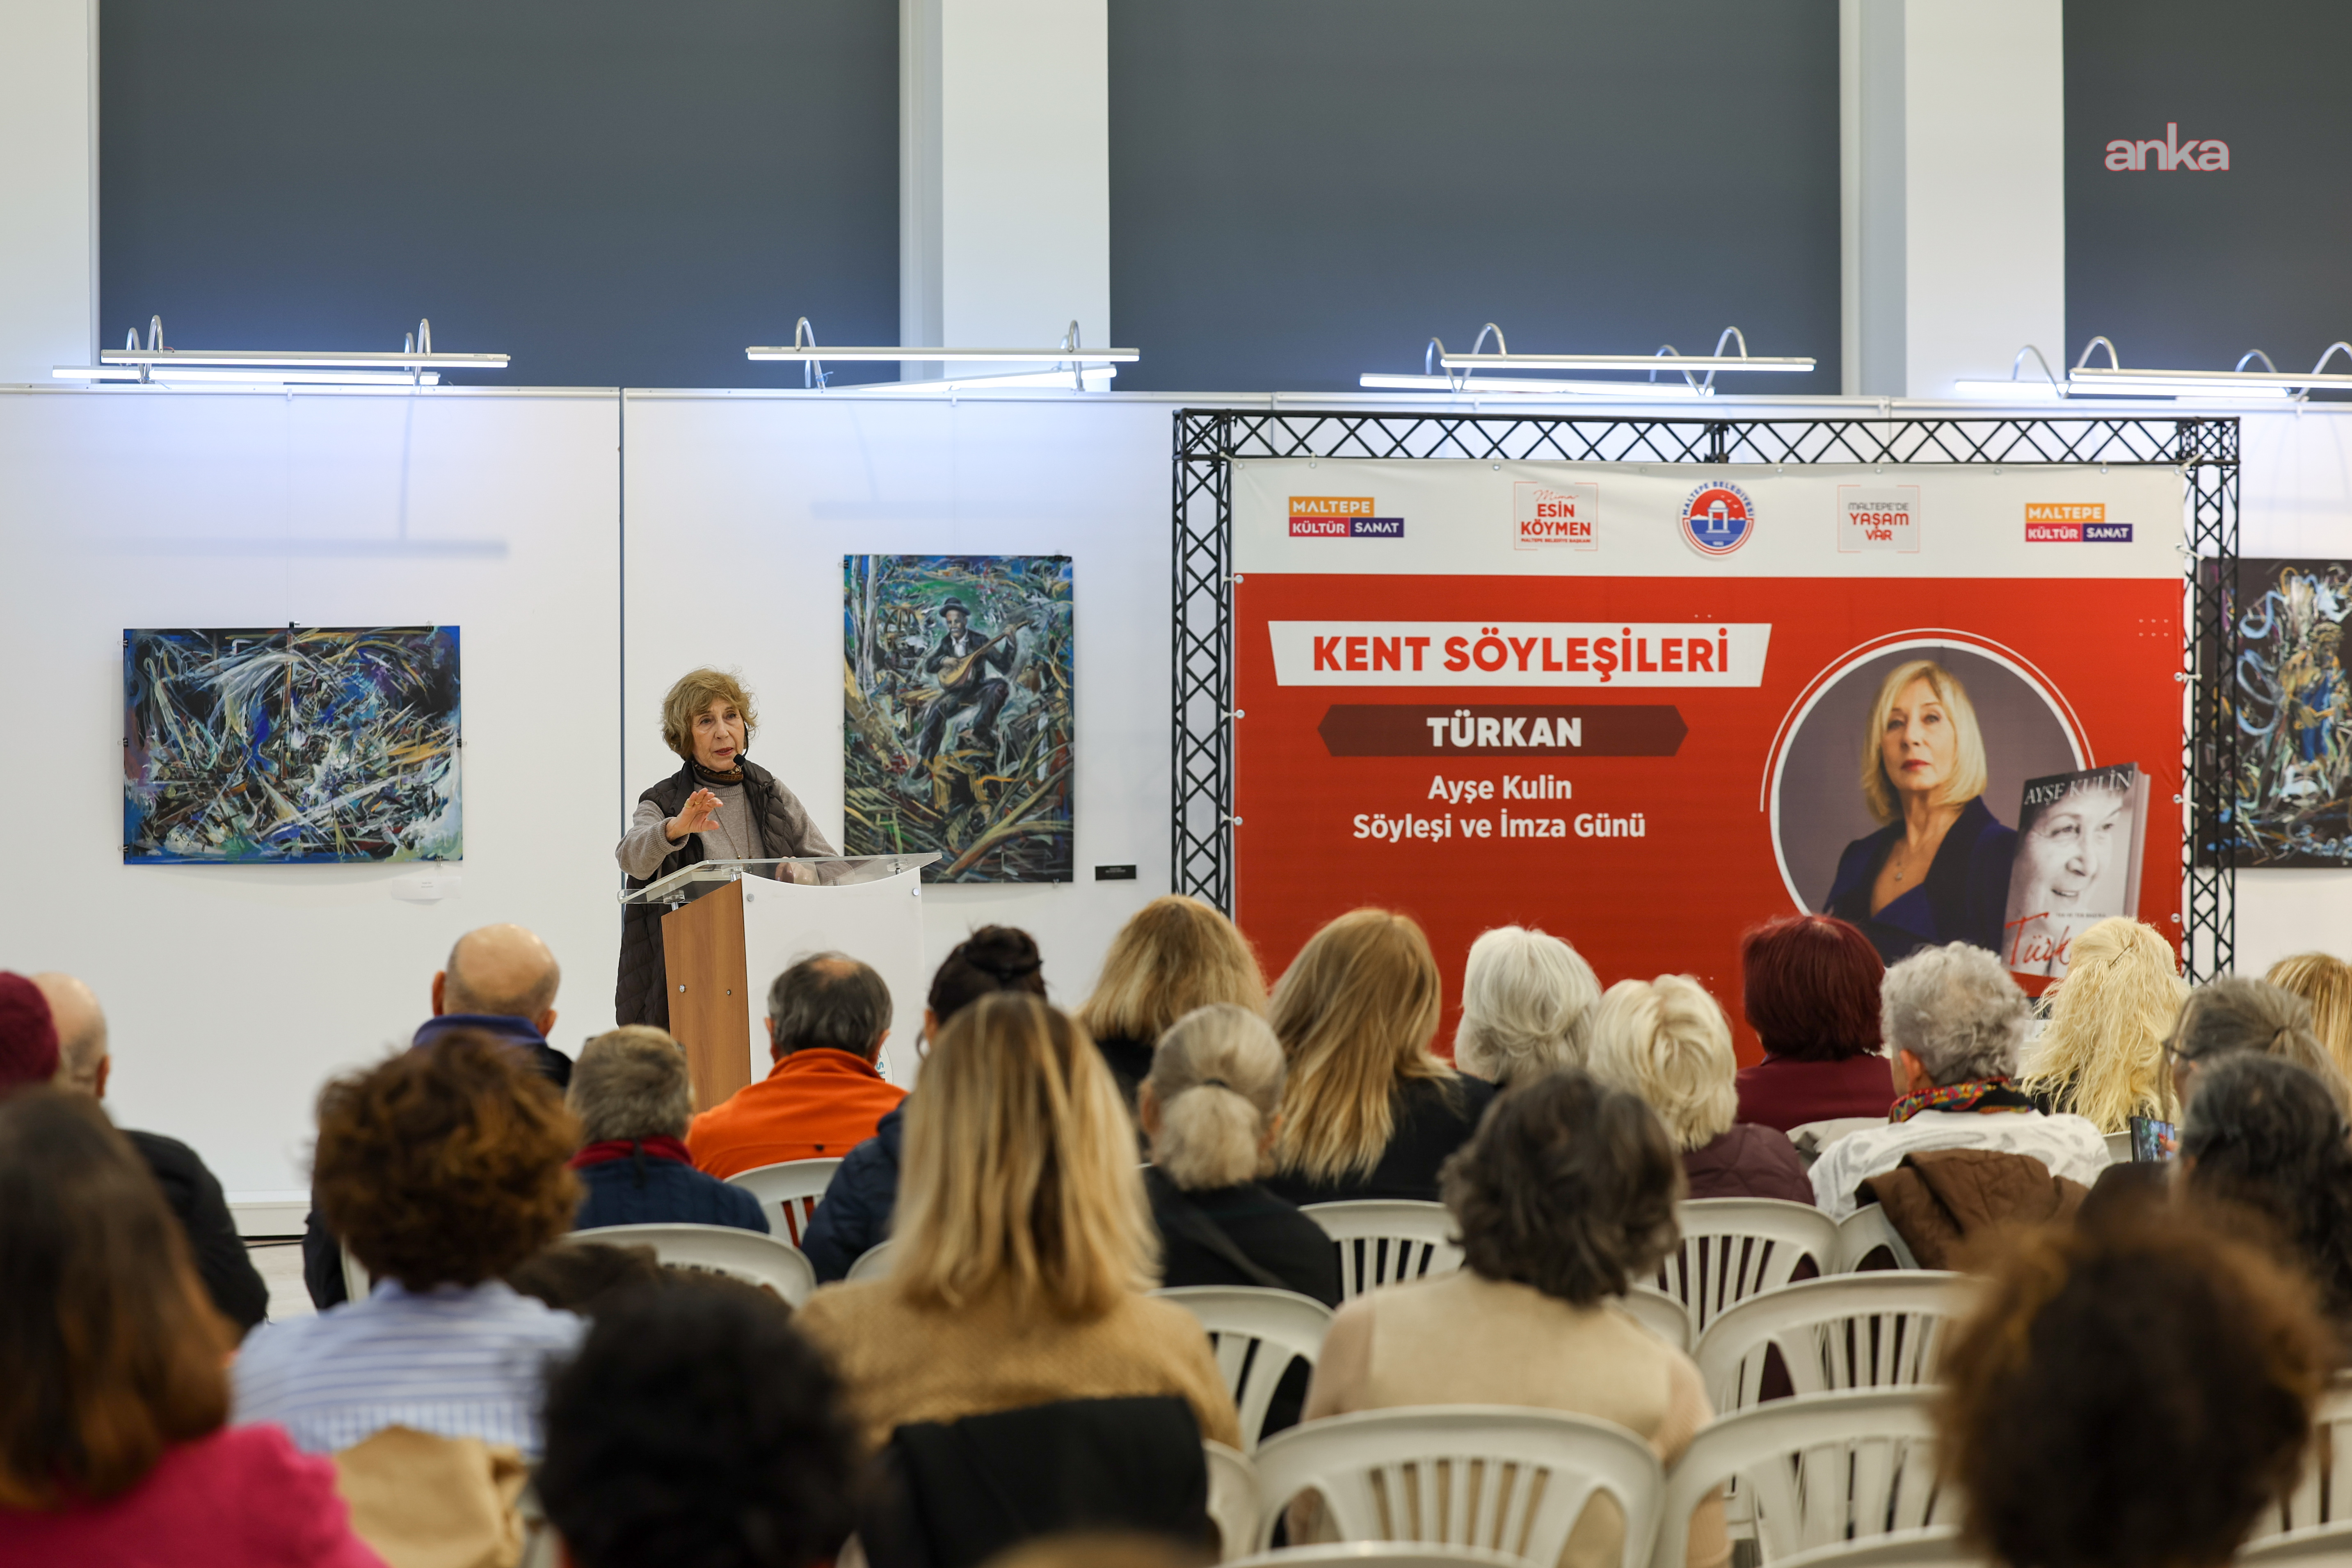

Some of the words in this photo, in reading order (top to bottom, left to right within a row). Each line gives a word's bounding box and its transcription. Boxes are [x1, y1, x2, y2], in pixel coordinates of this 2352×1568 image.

[1293, 500, 1370, 513] MALTEPE
[1683, 482, 1709, 516] MALTEPE
[1537, 501, 1575, 517] ESİN
[2028, 506, 2102, 519] MALTEPE
[1292, 520, 1345, 534] KÜLTÜR
[1355, 522, 1399, 533] SANAT
[1521, 519, 1591, 535] KÖYMEN
[1850, 512, 1909, 529] YAŞAM
[1865, 529, 1893, 540] VAR
[2027, 526, 2078, 539] KÜLTÜR
[2086, 527, 2129, 539] SANAT
[1314, 637, 1430, 670] KENT
[1444, 627, 1727, 682] SÖYLEŞİLERİ
[1426, 709, 1582, 747] TÜRKAN
[1428, 775, 1494, 804] Ayşe
[1503, 775, 1572, 799] Kulin
[1353, 813, 1451, 843] Söyleşi
[1460, 819, 1492, 838] ve
[1501, 808, 1566, 838] İmza
[1574, 812, 1645, 838] Günü
[2005, 912, 2071, 965] Türk
